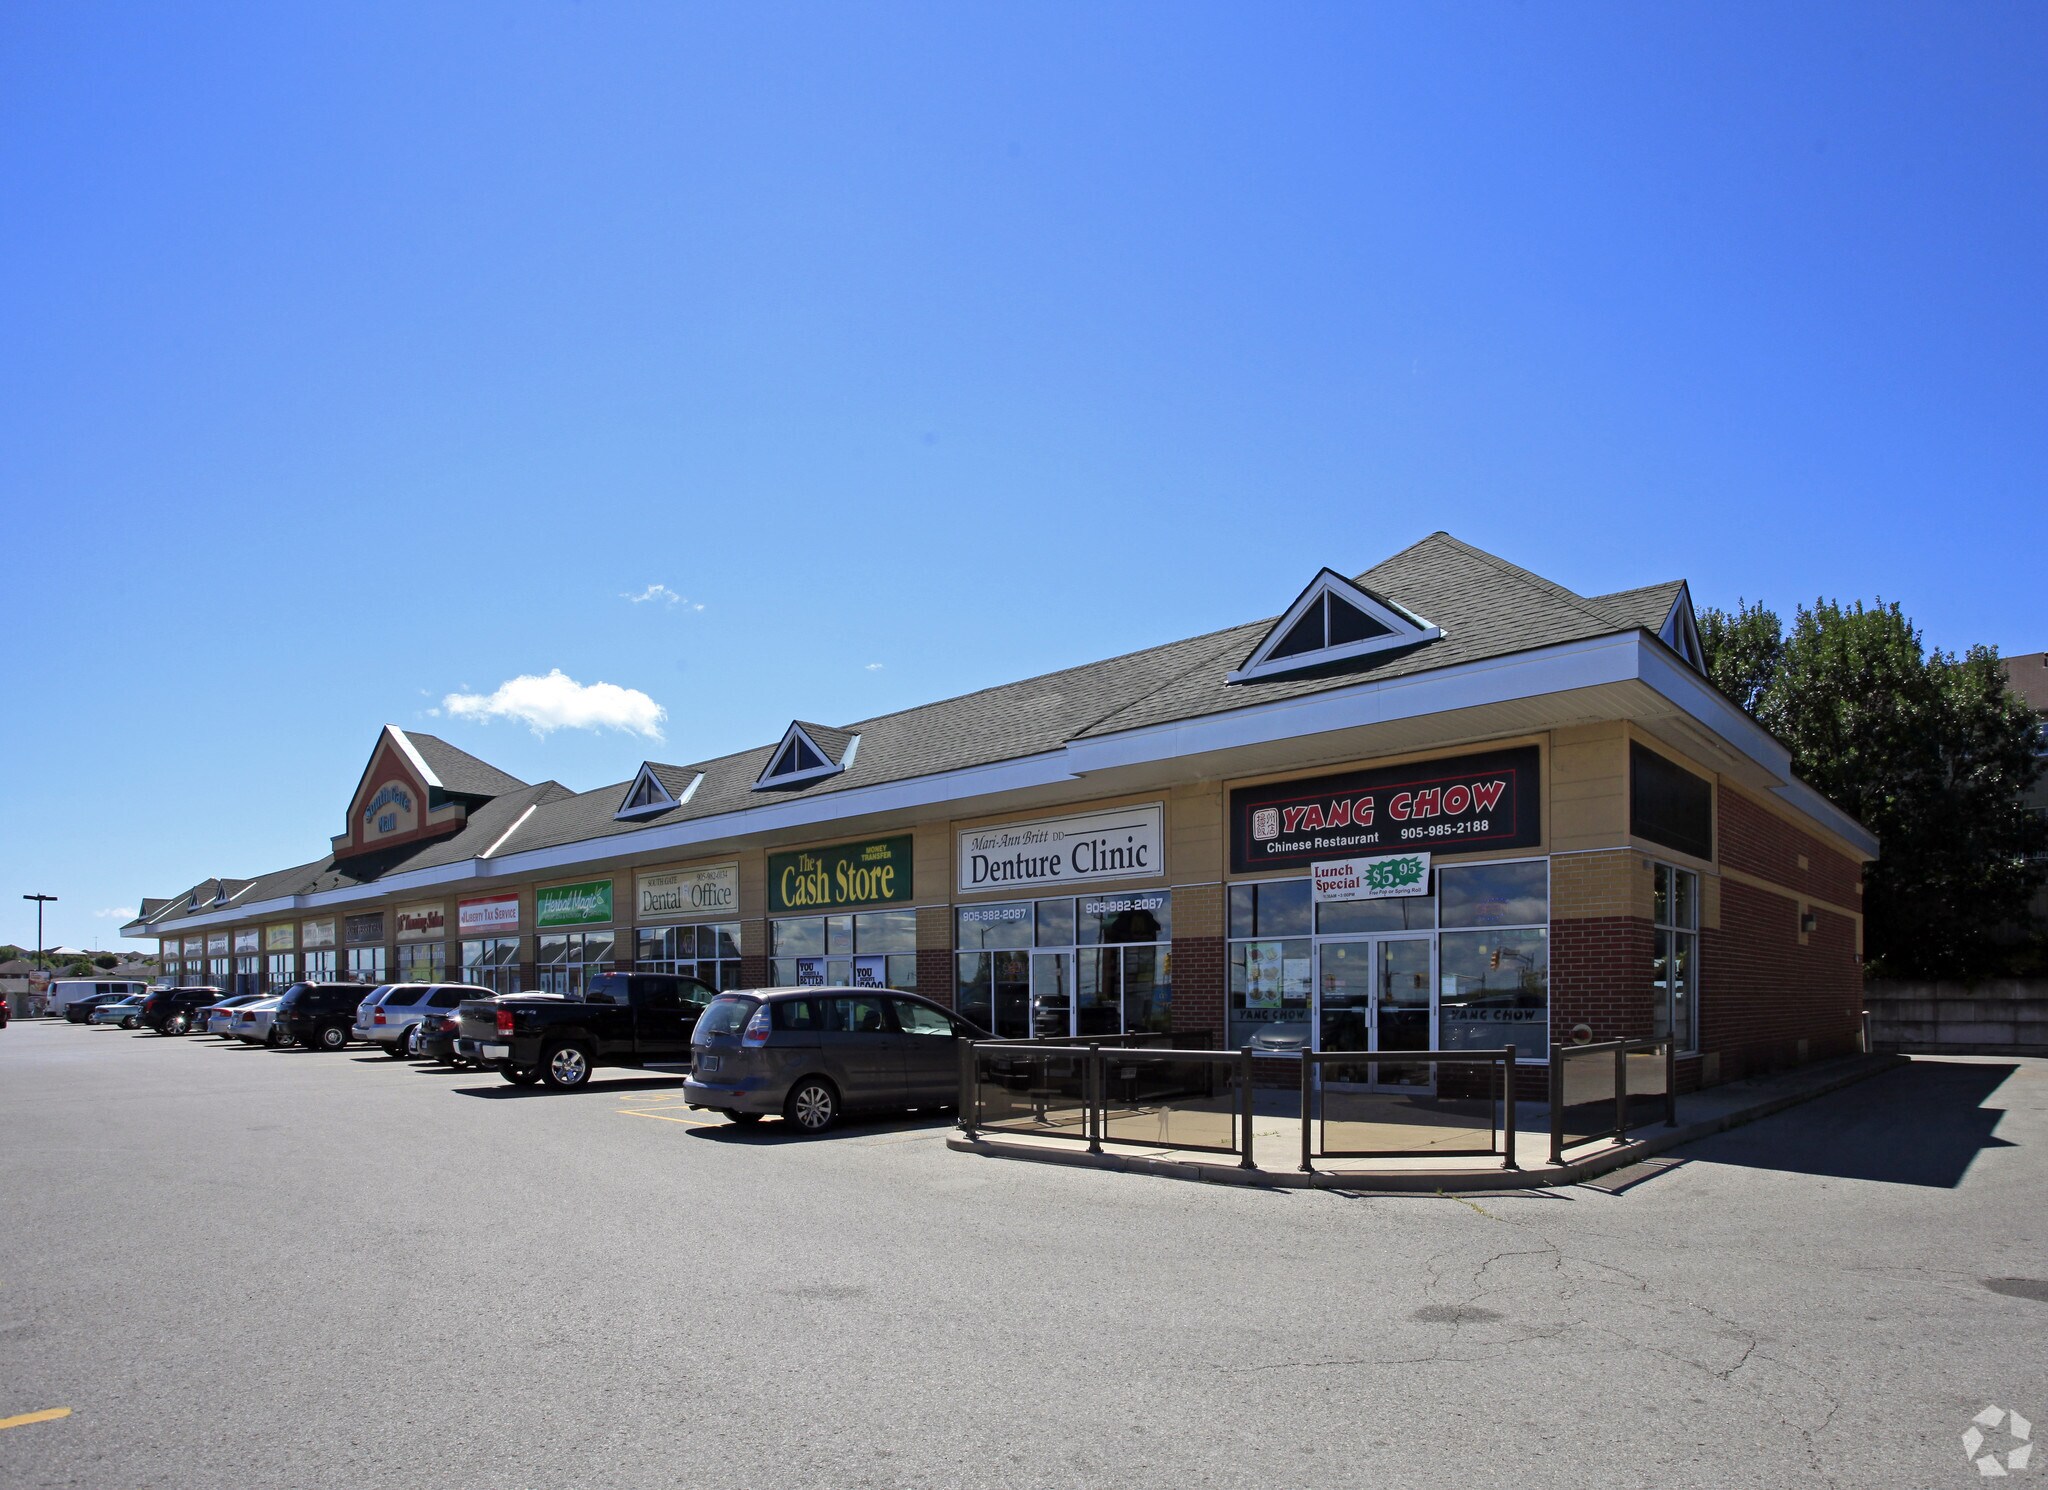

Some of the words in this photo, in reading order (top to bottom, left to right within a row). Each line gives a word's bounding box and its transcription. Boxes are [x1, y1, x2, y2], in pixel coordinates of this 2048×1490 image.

[1283, 796, 1375, 833] YANG
[1388, 780, 1506, 821] CHOW
[378, 812, 397, 833] Mall
[1400, 820, 1489, 840] 905-985-2188
[971, 833, 1021, 851] Mari-Ann
[1022, 829, 1049, 846] Britt
[1053, 831, 1064, 842] DD
[1266, 839, 1312, 854] Chinese
[1314, 831, 1380, 849] Restaurant
[861, 851, 892, 861] TRANSFER
[865, 844, 888, 854] MONEY
[798, 853, 815, 872] The
[971, 852, 1061, 884] Denture
[1071, 835, 1148, 874] Clinic
[1314, 864, 1353, 878] Lunch
[781, 859, 831, 907] Cash
[835, 860, 895, 903] Store
[1316, 876, 1360, 892] Special
[543, 890, 572, 913] Herbal
[572, 889, 597, 919] Magic
[643, 886, 682, 911] Dental
[691, 882, 732, 908] Office
[962, 908, 1027, 922] 905-982-2087
[1085, 898, 1163, 915] 905-982-2087
[800, 962, 814, 971] YOU
[856, 967, 872, 978] YOU
[800, 975, 824, 985] BETTER
[1240, 1010, 1268, 1020] YANG
[1272, 1010, 1305, 1020] CHOW
[1450, 1010, 1488, 1021] YANG
[1493, 1009, 1536, 1020] CHOW
